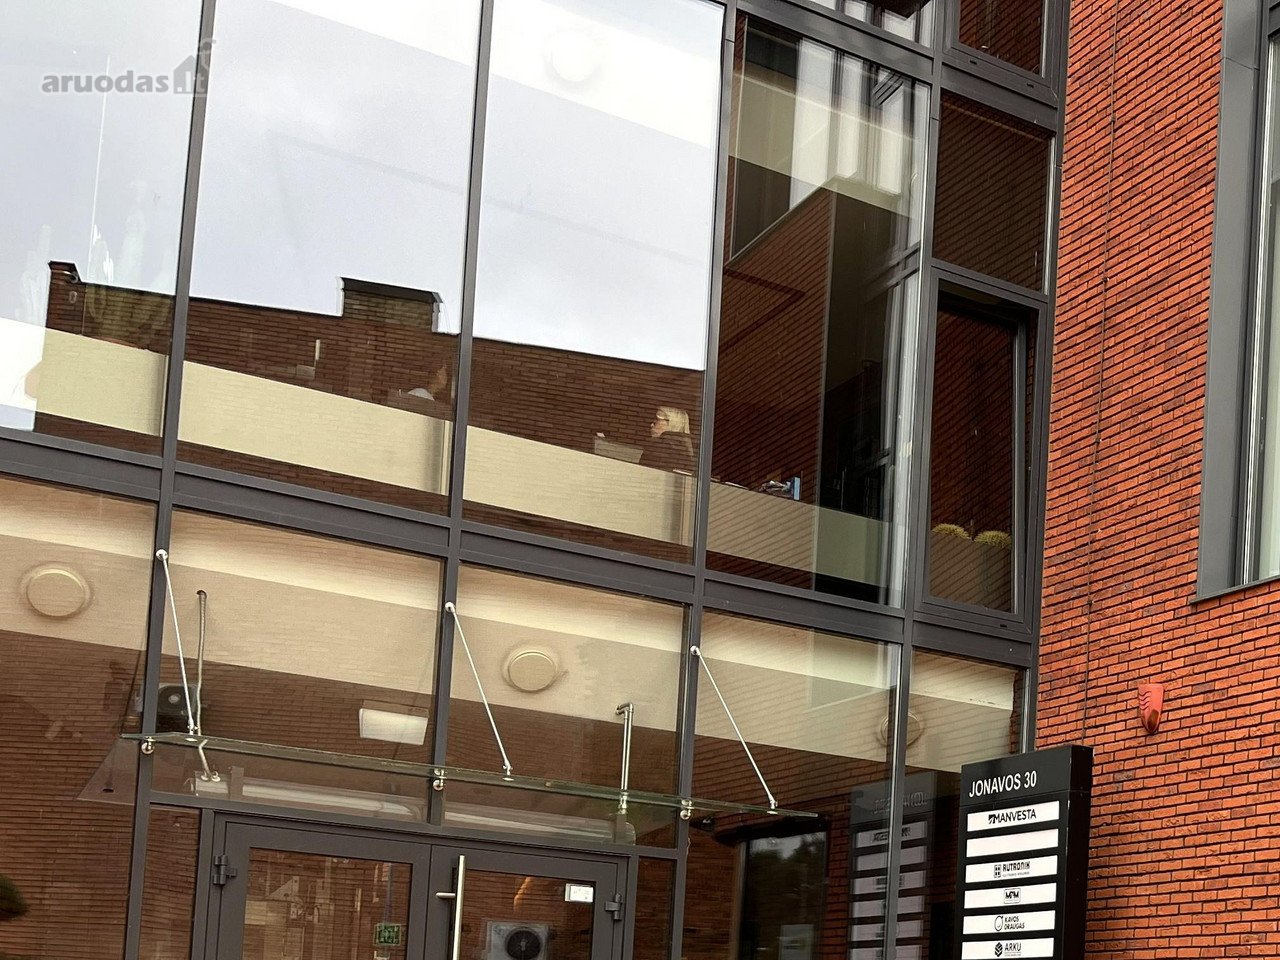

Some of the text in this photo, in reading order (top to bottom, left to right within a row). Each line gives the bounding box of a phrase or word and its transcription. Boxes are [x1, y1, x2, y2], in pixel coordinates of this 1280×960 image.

[969, 770, 1037, 798] JONAVOS 30
[994, 808, 1037, 824] MANVESTA
[1002, 861, 1030, 872] RUTRONIK
[1004, 922, 1025, 930] DRAUGAS
[1004, 942, 1022, 952] ARKU
